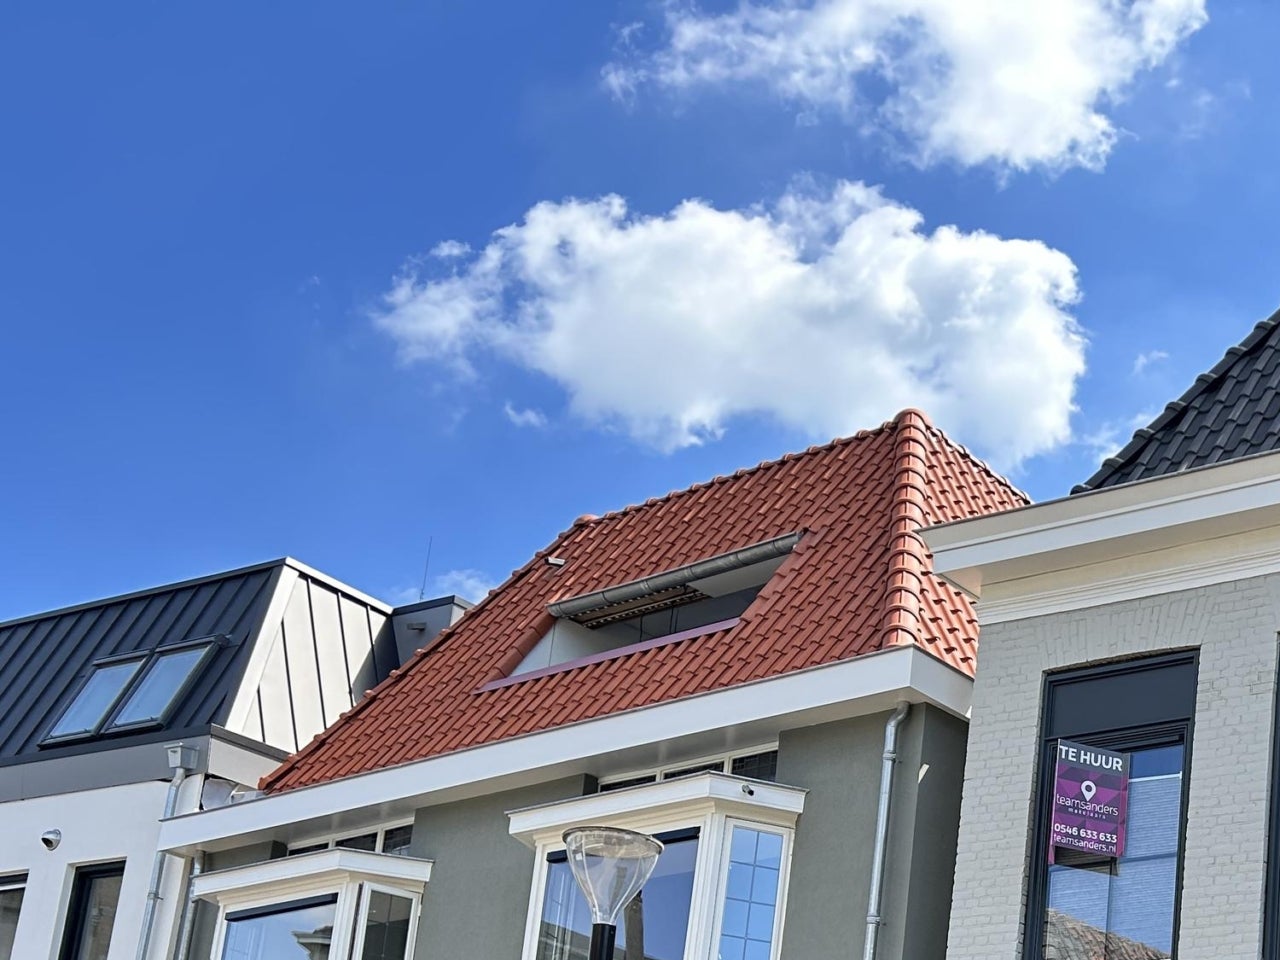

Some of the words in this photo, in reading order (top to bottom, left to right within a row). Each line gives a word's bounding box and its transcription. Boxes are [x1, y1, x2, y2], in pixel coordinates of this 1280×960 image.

[1059, 745, 1077, 762] TE
[1080, 750, 1123, 772] HUUR
[1056, 793, 1119, 816] teamsanders
[1053, 833, 1117, 853] teamsanders.nl
[1054, 823, 1078, 836] 0546
[1079, 828, 1098, 840] 633
[1099, 832, 1118, 843] 633
